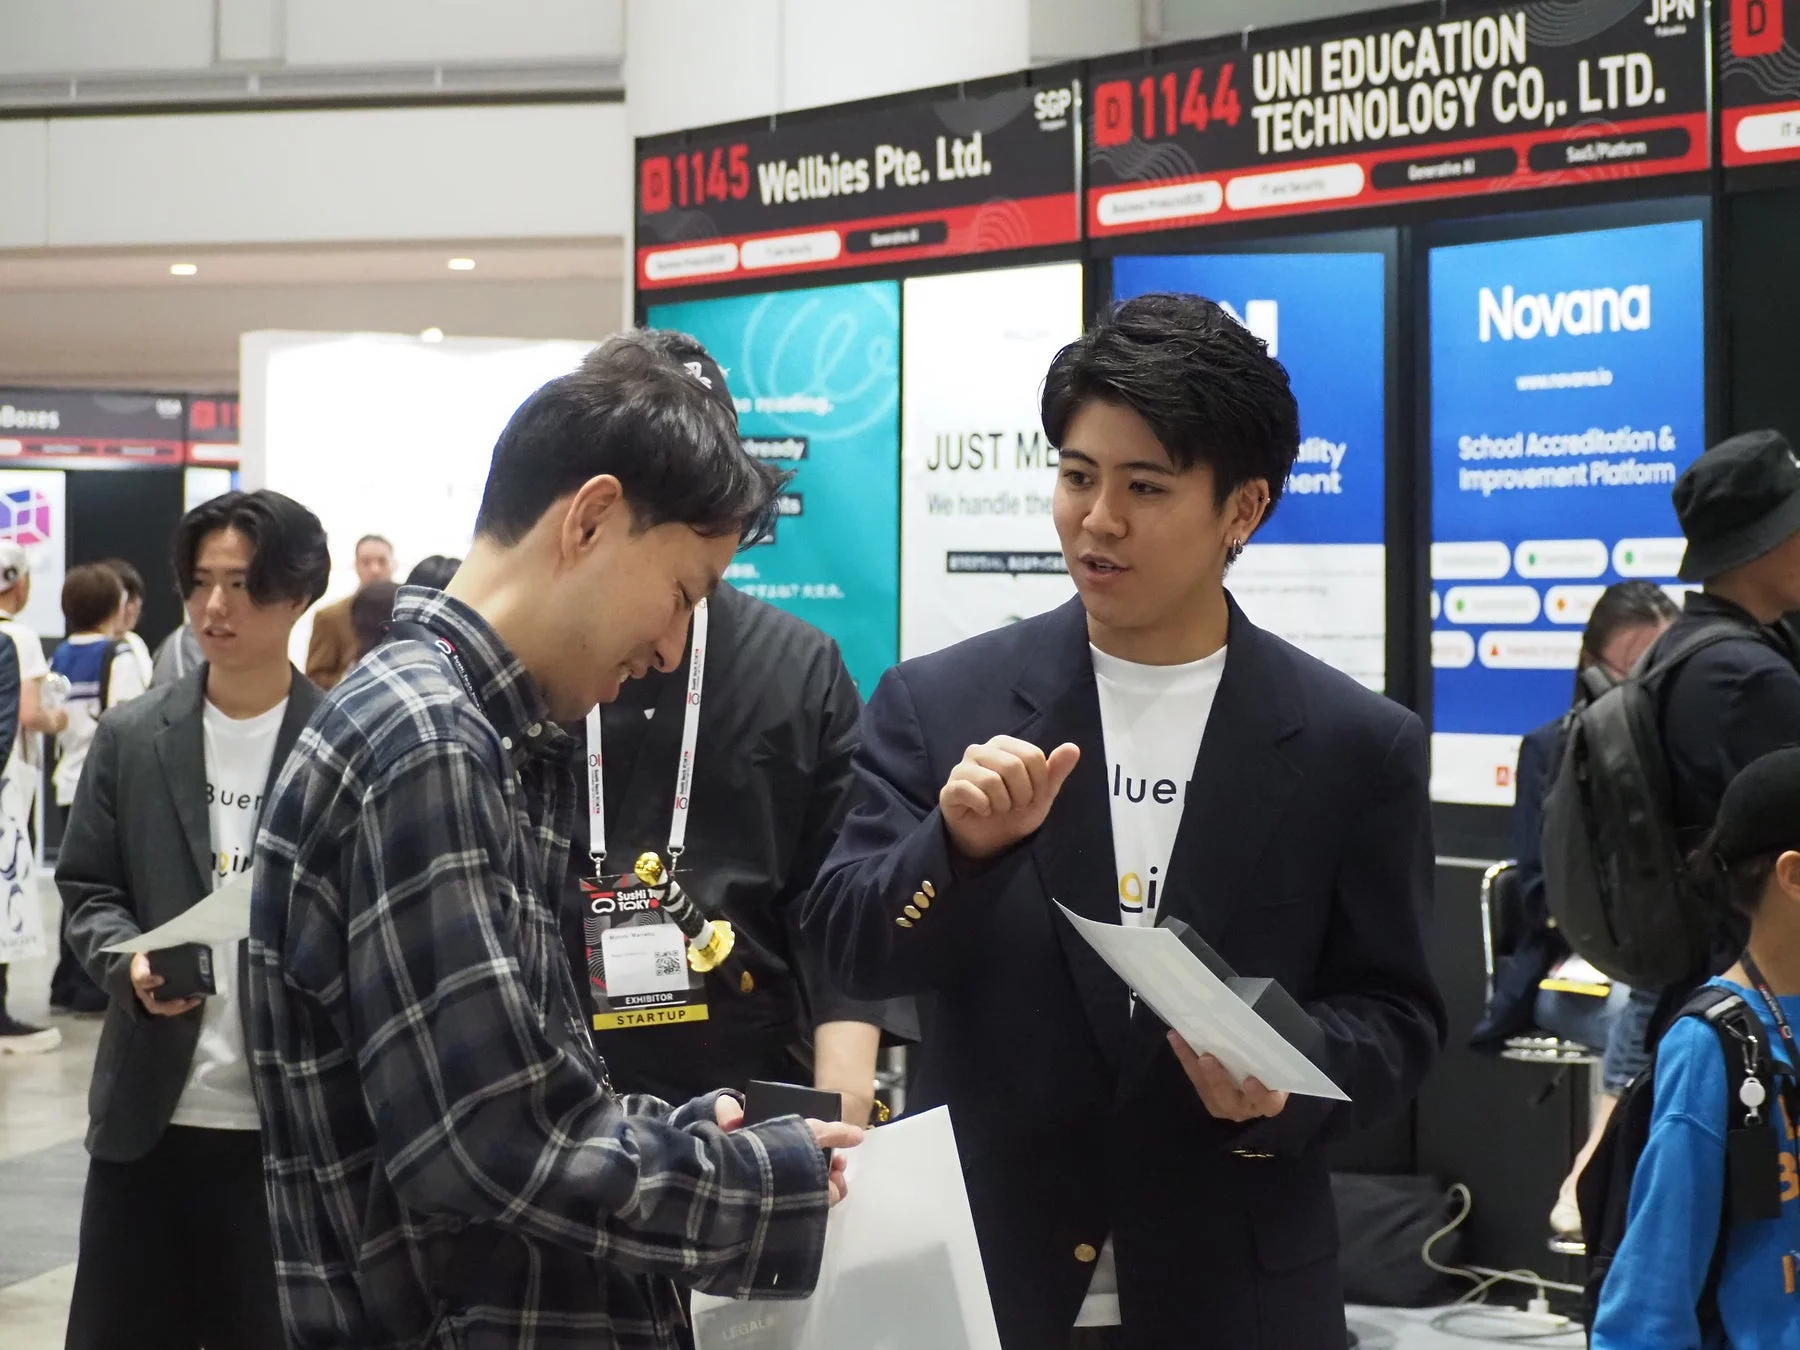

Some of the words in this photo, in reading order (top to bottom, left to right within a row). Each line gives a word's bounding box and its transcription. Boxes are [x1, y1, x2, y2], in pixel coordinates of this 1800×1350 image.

[1644, 0, 1695, 25] JPN
[1252, 45, 1312, 102] UNI
[1322, 11, 1527, 93] EDUCATION
[1034, 88, 1072, 119] SGP
[1139, 63, 1242, 139] 1144
[1251, 74, 1482, 154] TECHNOLOGY
[1492, 67, 1567, 126] CO,.
[1578, 53, 1666, 113] LTD.
[675, 143, 750, 206] 1145
[758, 152, 869, 206] Wellbies
[875, 144, 929, 188] Pte.
[937, 130, 992, 180] Ltd.
[1478, 284, 1651, 343] Novana
[0, 404, 60, 430] Boxes
[927, 432, 1003, 471] JUST
[1458, 433, 1524, 460] School
[1525, 425, 1656, 457] Accreditation
[1657, 425, 1677, 452] &
[1459, 463, 1589, 498] Improvement
[1590, 457, 1677, 487] Platform
[927, 493, 953, 516] We
[958, 490, 1020, 516] handle
[1113, 763, 1191, 805] lue
[617, 889, 647, 902] SusHi
[617, 1009, 686, 1026] STARTUP
[625, 992, 674, 1006] EXHIBITOR
